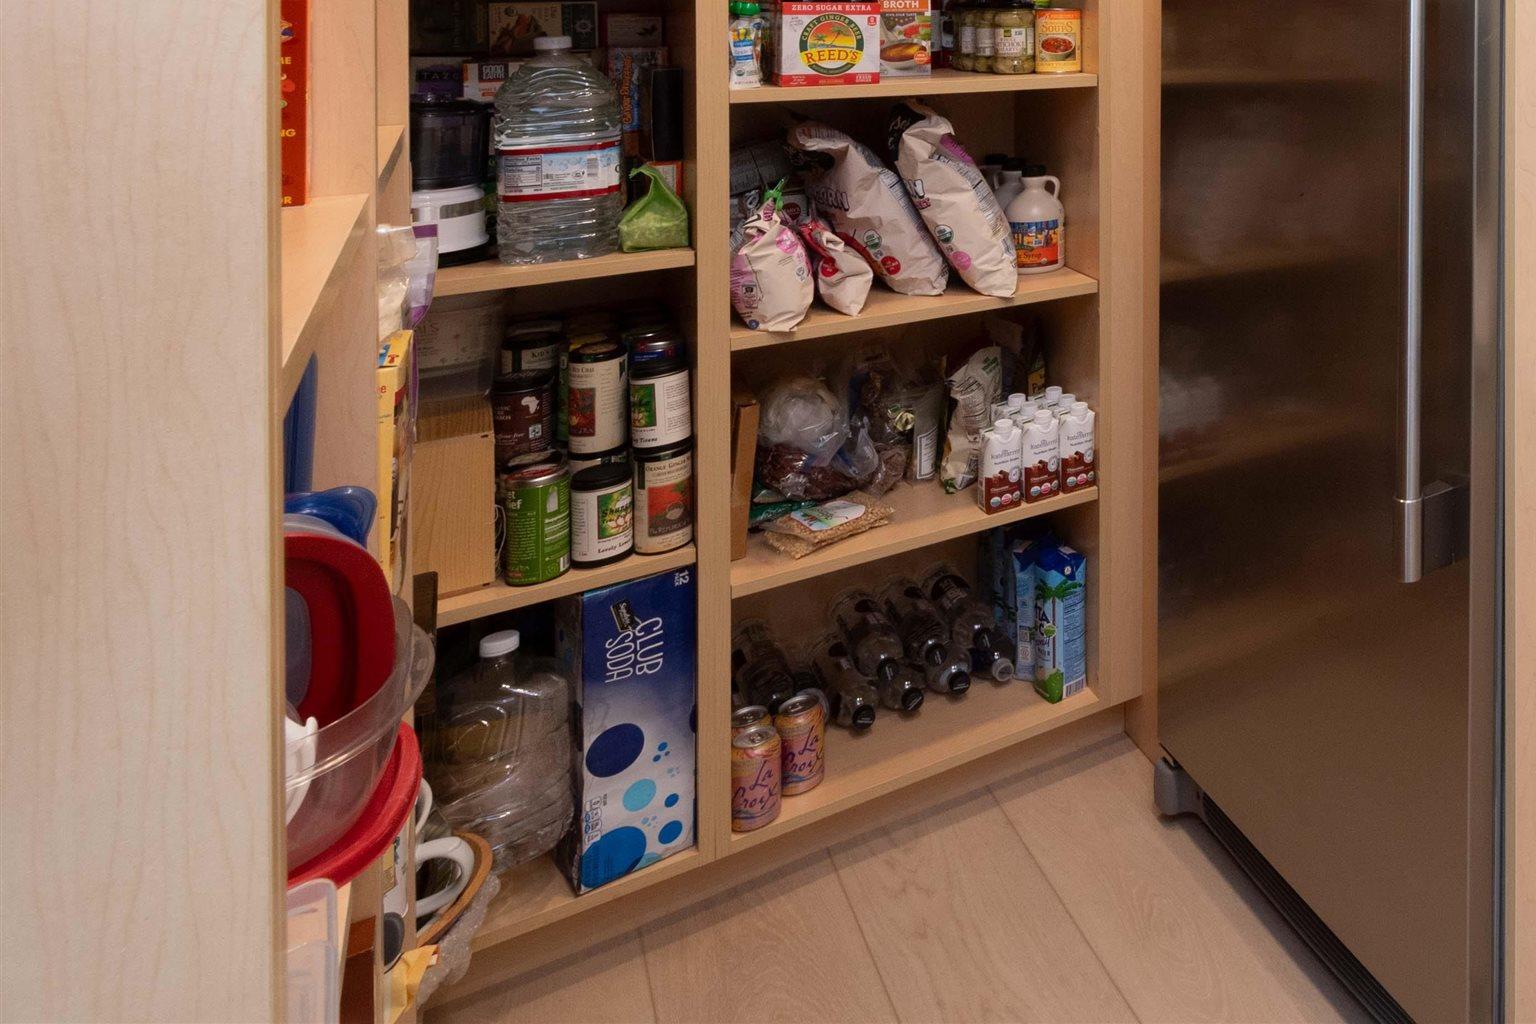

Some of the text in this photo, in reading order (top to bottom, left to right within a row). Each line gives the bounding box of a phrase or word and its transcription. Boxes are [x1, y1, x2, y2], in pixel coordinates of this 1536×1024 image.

[883, 1, 919, 9] BROTH
[805, 49, 859, 64] REED'S
[679, 569, 690, 585] 12
[604, 631, 635, 683] SODA
[635, 617, 664, 675] CLUB
[749, 759, 774, 791] La
